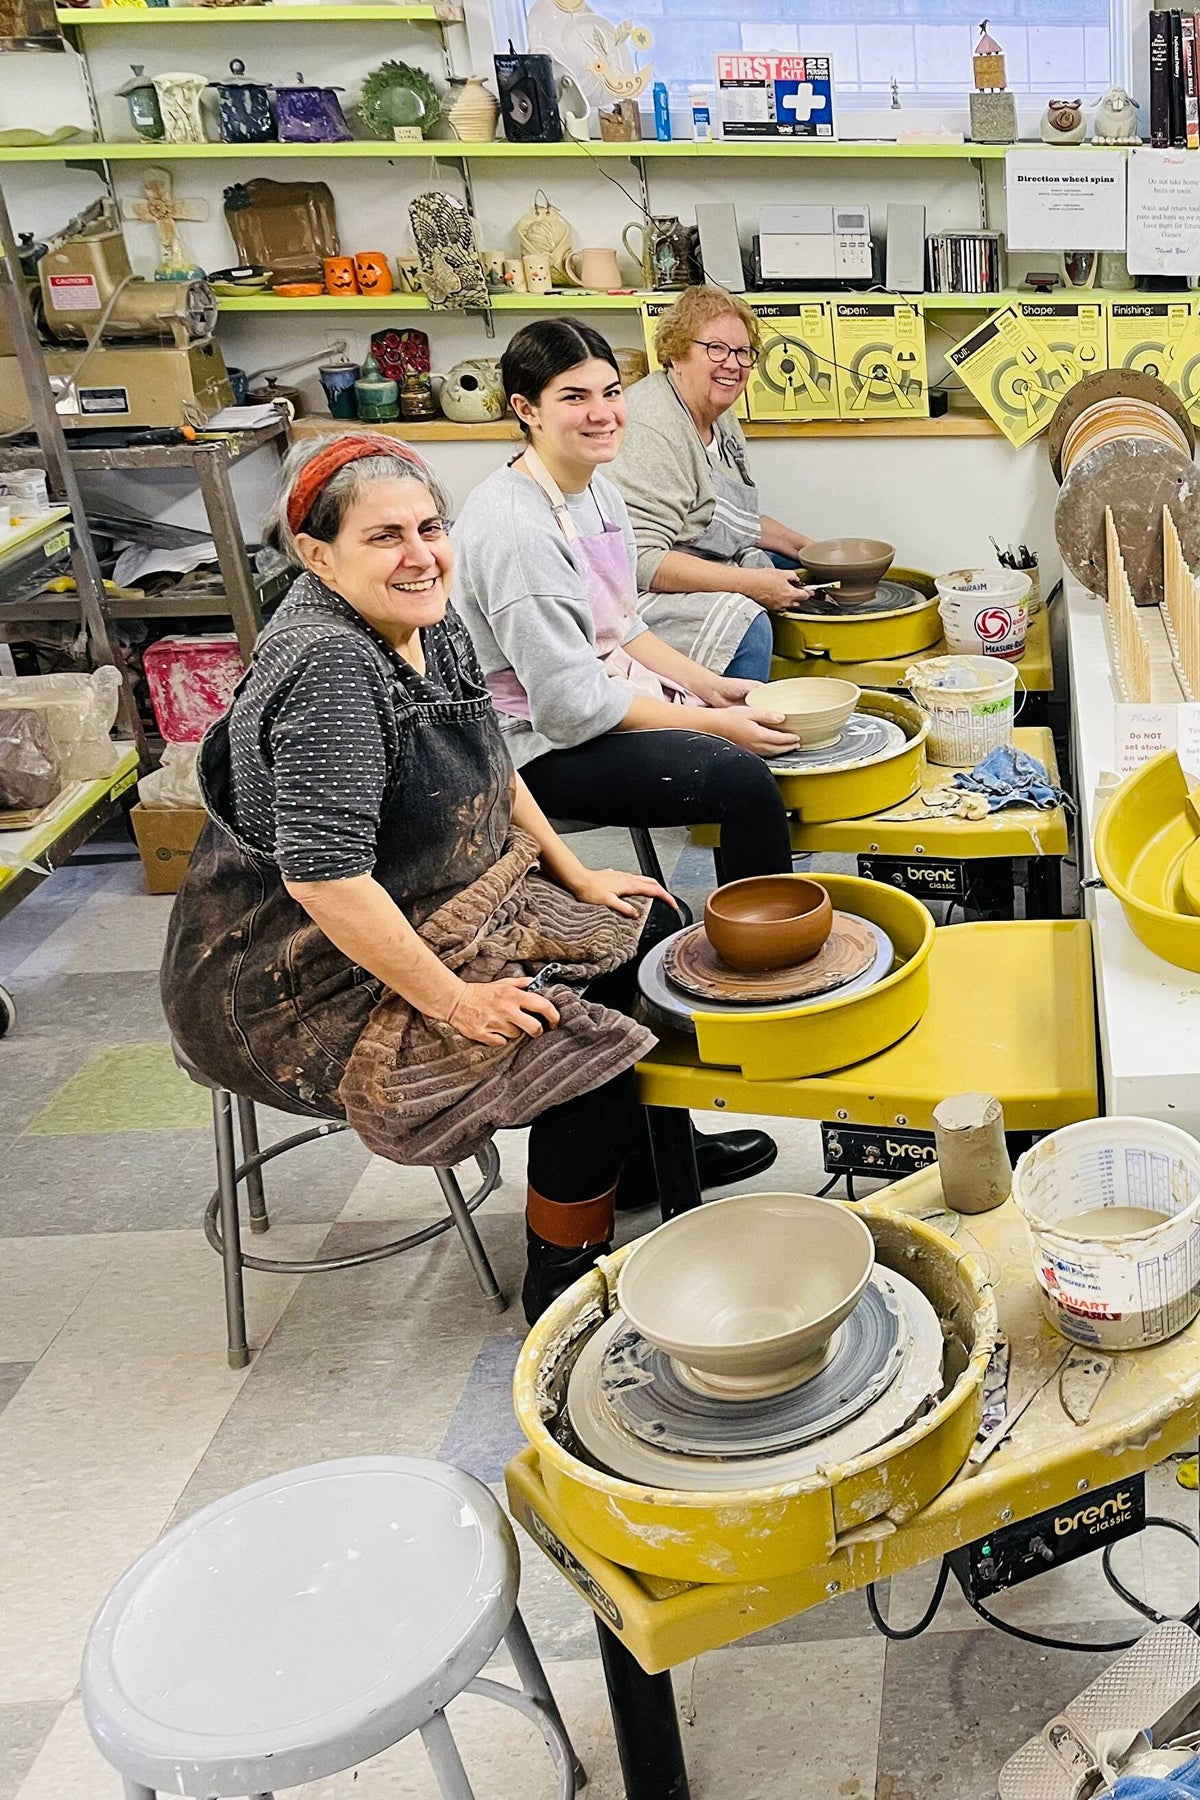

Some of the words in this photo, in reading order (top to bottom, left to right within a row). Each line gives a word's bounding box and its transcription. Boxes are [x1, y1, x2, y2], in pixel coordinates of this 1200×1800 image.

[719, 57, 779, 80] FIRST
[781, 58, 804, 69] AID
[806, 58, 828, 69] 25
[781, 69, 804, 80] KIT
[1017, 175, 1060, 183] Direction
[1090, 176, 1115, 184] spins
[752, 306, 780, 315] enter:
[838, 305, 869, 316] Open:
[1023, 305, 1056, 316] Shape:
[1113, 305, 1154, 316] Finishing:
[952, 347, 971, 363] Pull:
[907, 866, 956, 882] brent
[929, 882, 956, 890] classic
[1059, 1292, 1110, 1311] QUART
[1054, 1491, 1132, 1536] brent
[1089, 1511, 1132, 1535] classic
